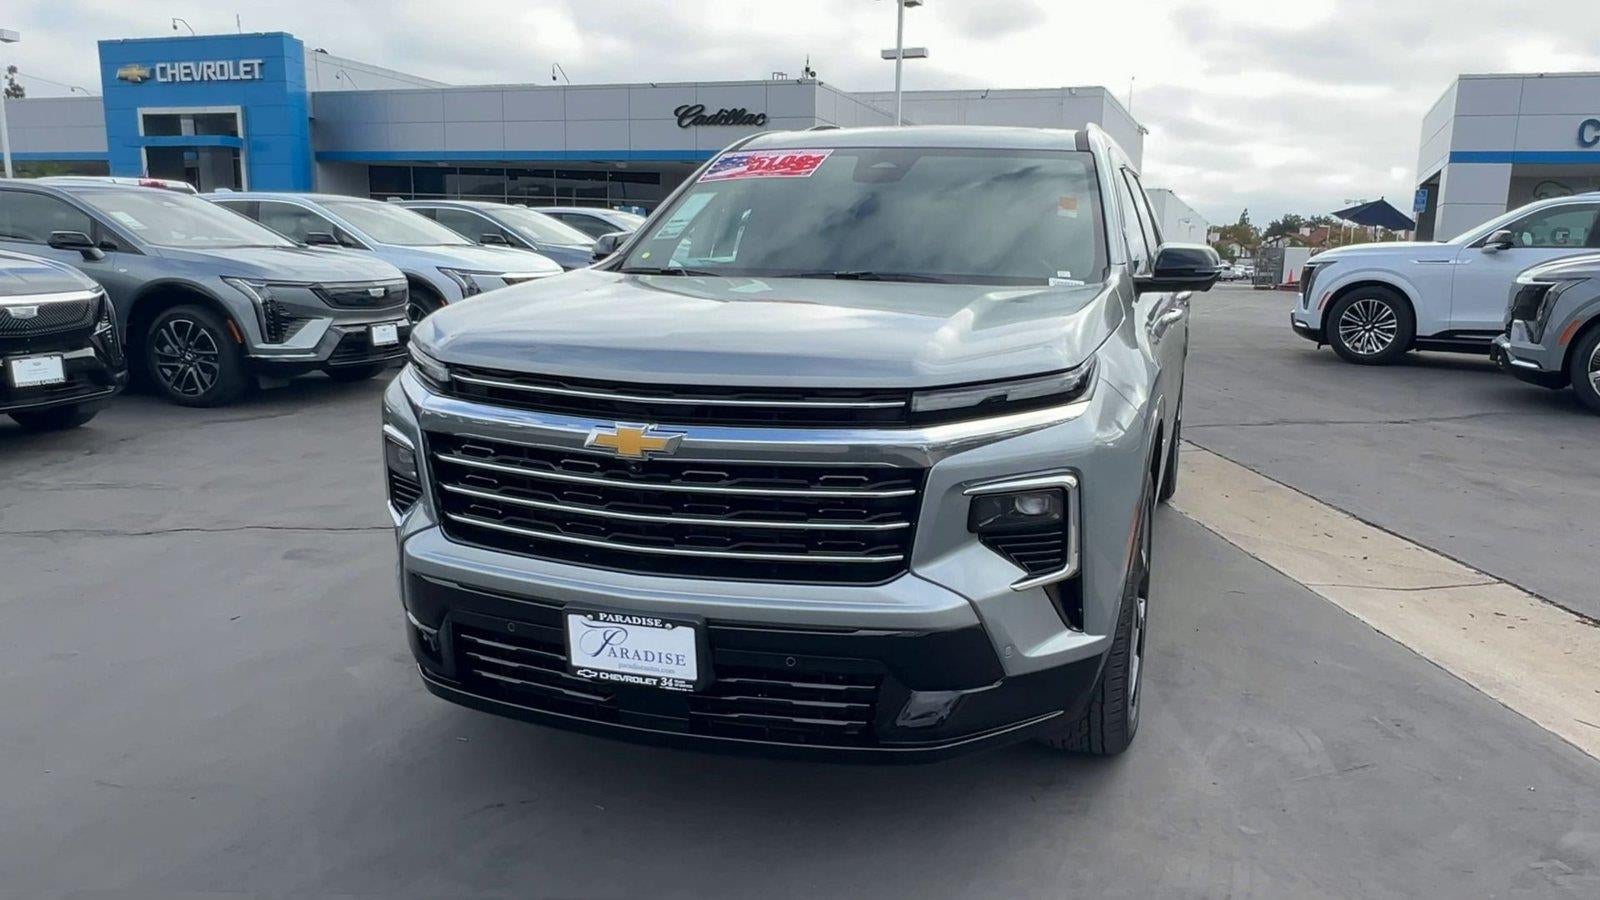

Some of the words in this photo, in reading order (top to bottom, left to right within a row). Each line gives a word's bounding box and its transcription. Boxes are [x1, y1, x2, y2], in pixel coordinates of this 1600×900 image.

[155, 59, 263, 82] CHEVROLET
[674, 104, 767, 128] Cadillac
[599, 612, 662, 627] PARADISE
[579, 620, 687, 667] PARADISE
[600, 673, 658, 686] CHEVROLET
[660, 676, 674, 688] 34
